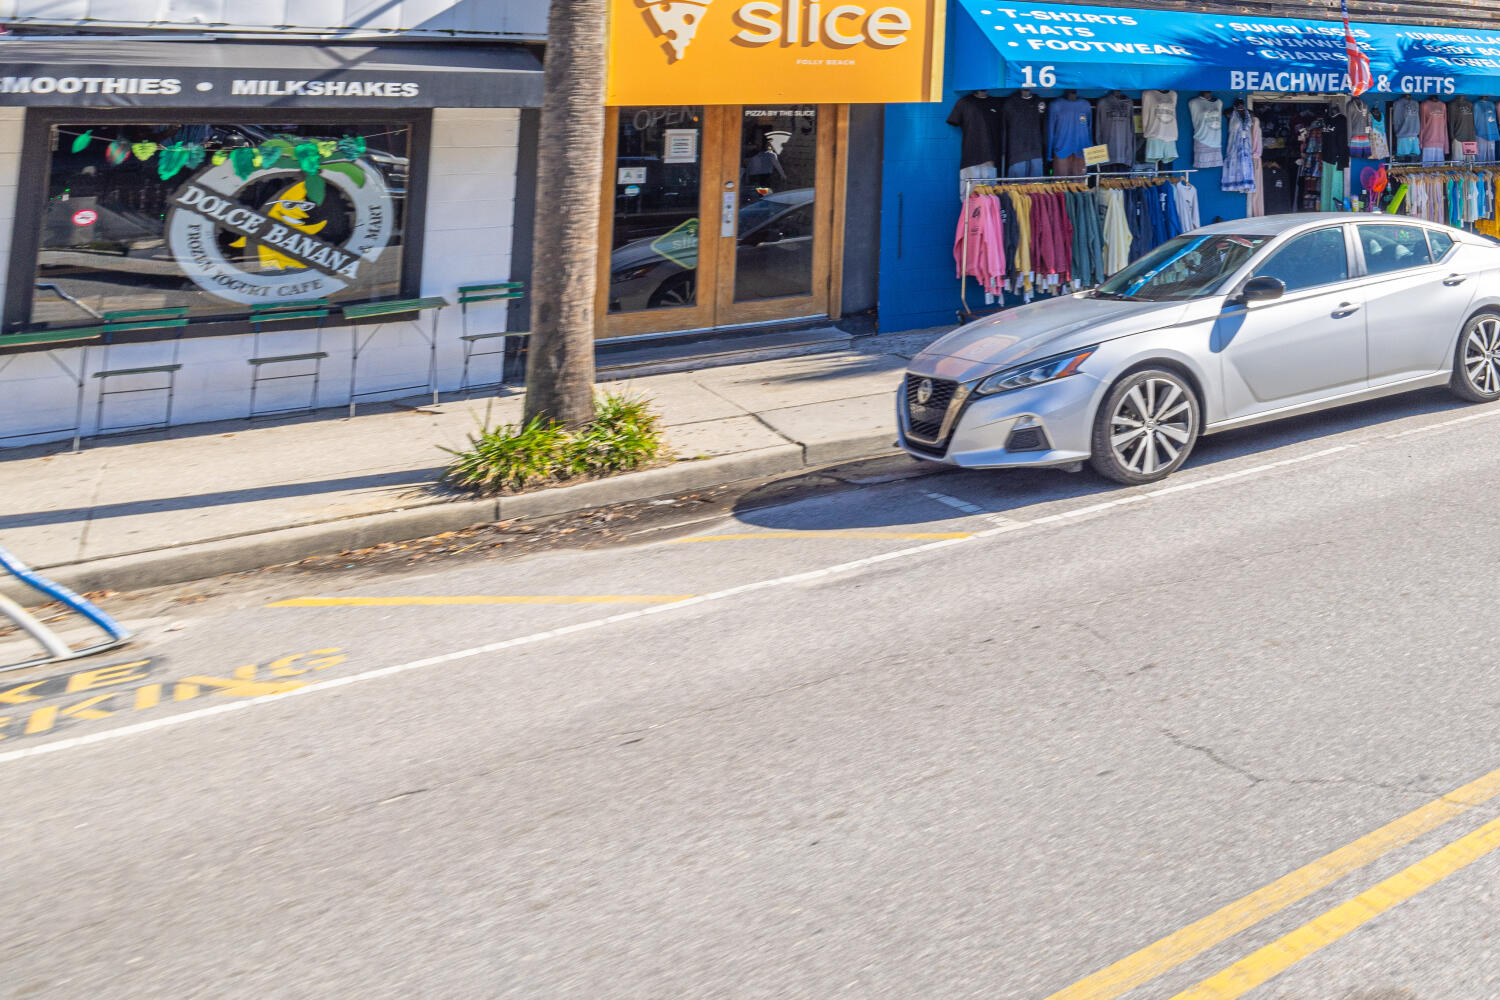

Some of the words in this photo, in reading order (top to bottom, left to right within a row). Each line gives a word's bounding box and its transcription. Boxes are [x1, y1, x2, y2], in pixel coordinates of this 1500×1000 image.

[997, 8, 1138, 26] T-SHIRTS
[1013, 23, 1095, 38] HATS
[1027, 38, 1193, 56] FOOTWEAR
[1245, 35, 1377, 51] SWIMWER
[1423, 44, 1474, 55] BODY
[1260, 49, 1348, 62] CHAIRS
[1020, 65, 1057, 89] 16
[1230, 70, 1352, 92] BEACHWEA
[1377, 74, 1392, 93] &
[1401, 75, 1455, 95] GIFTS
[231, 79, 420, 97] MILKSHAKES
[633, 107, 696, 131] OPEN
[176, 185, 267, 235] DOLCE
[364, 204, 383, 240] MART
[261, 223, 361, 280] BANANA
[212, 270, 273, 298] YOGURT
[277, 278, 324, 297] CAFE
